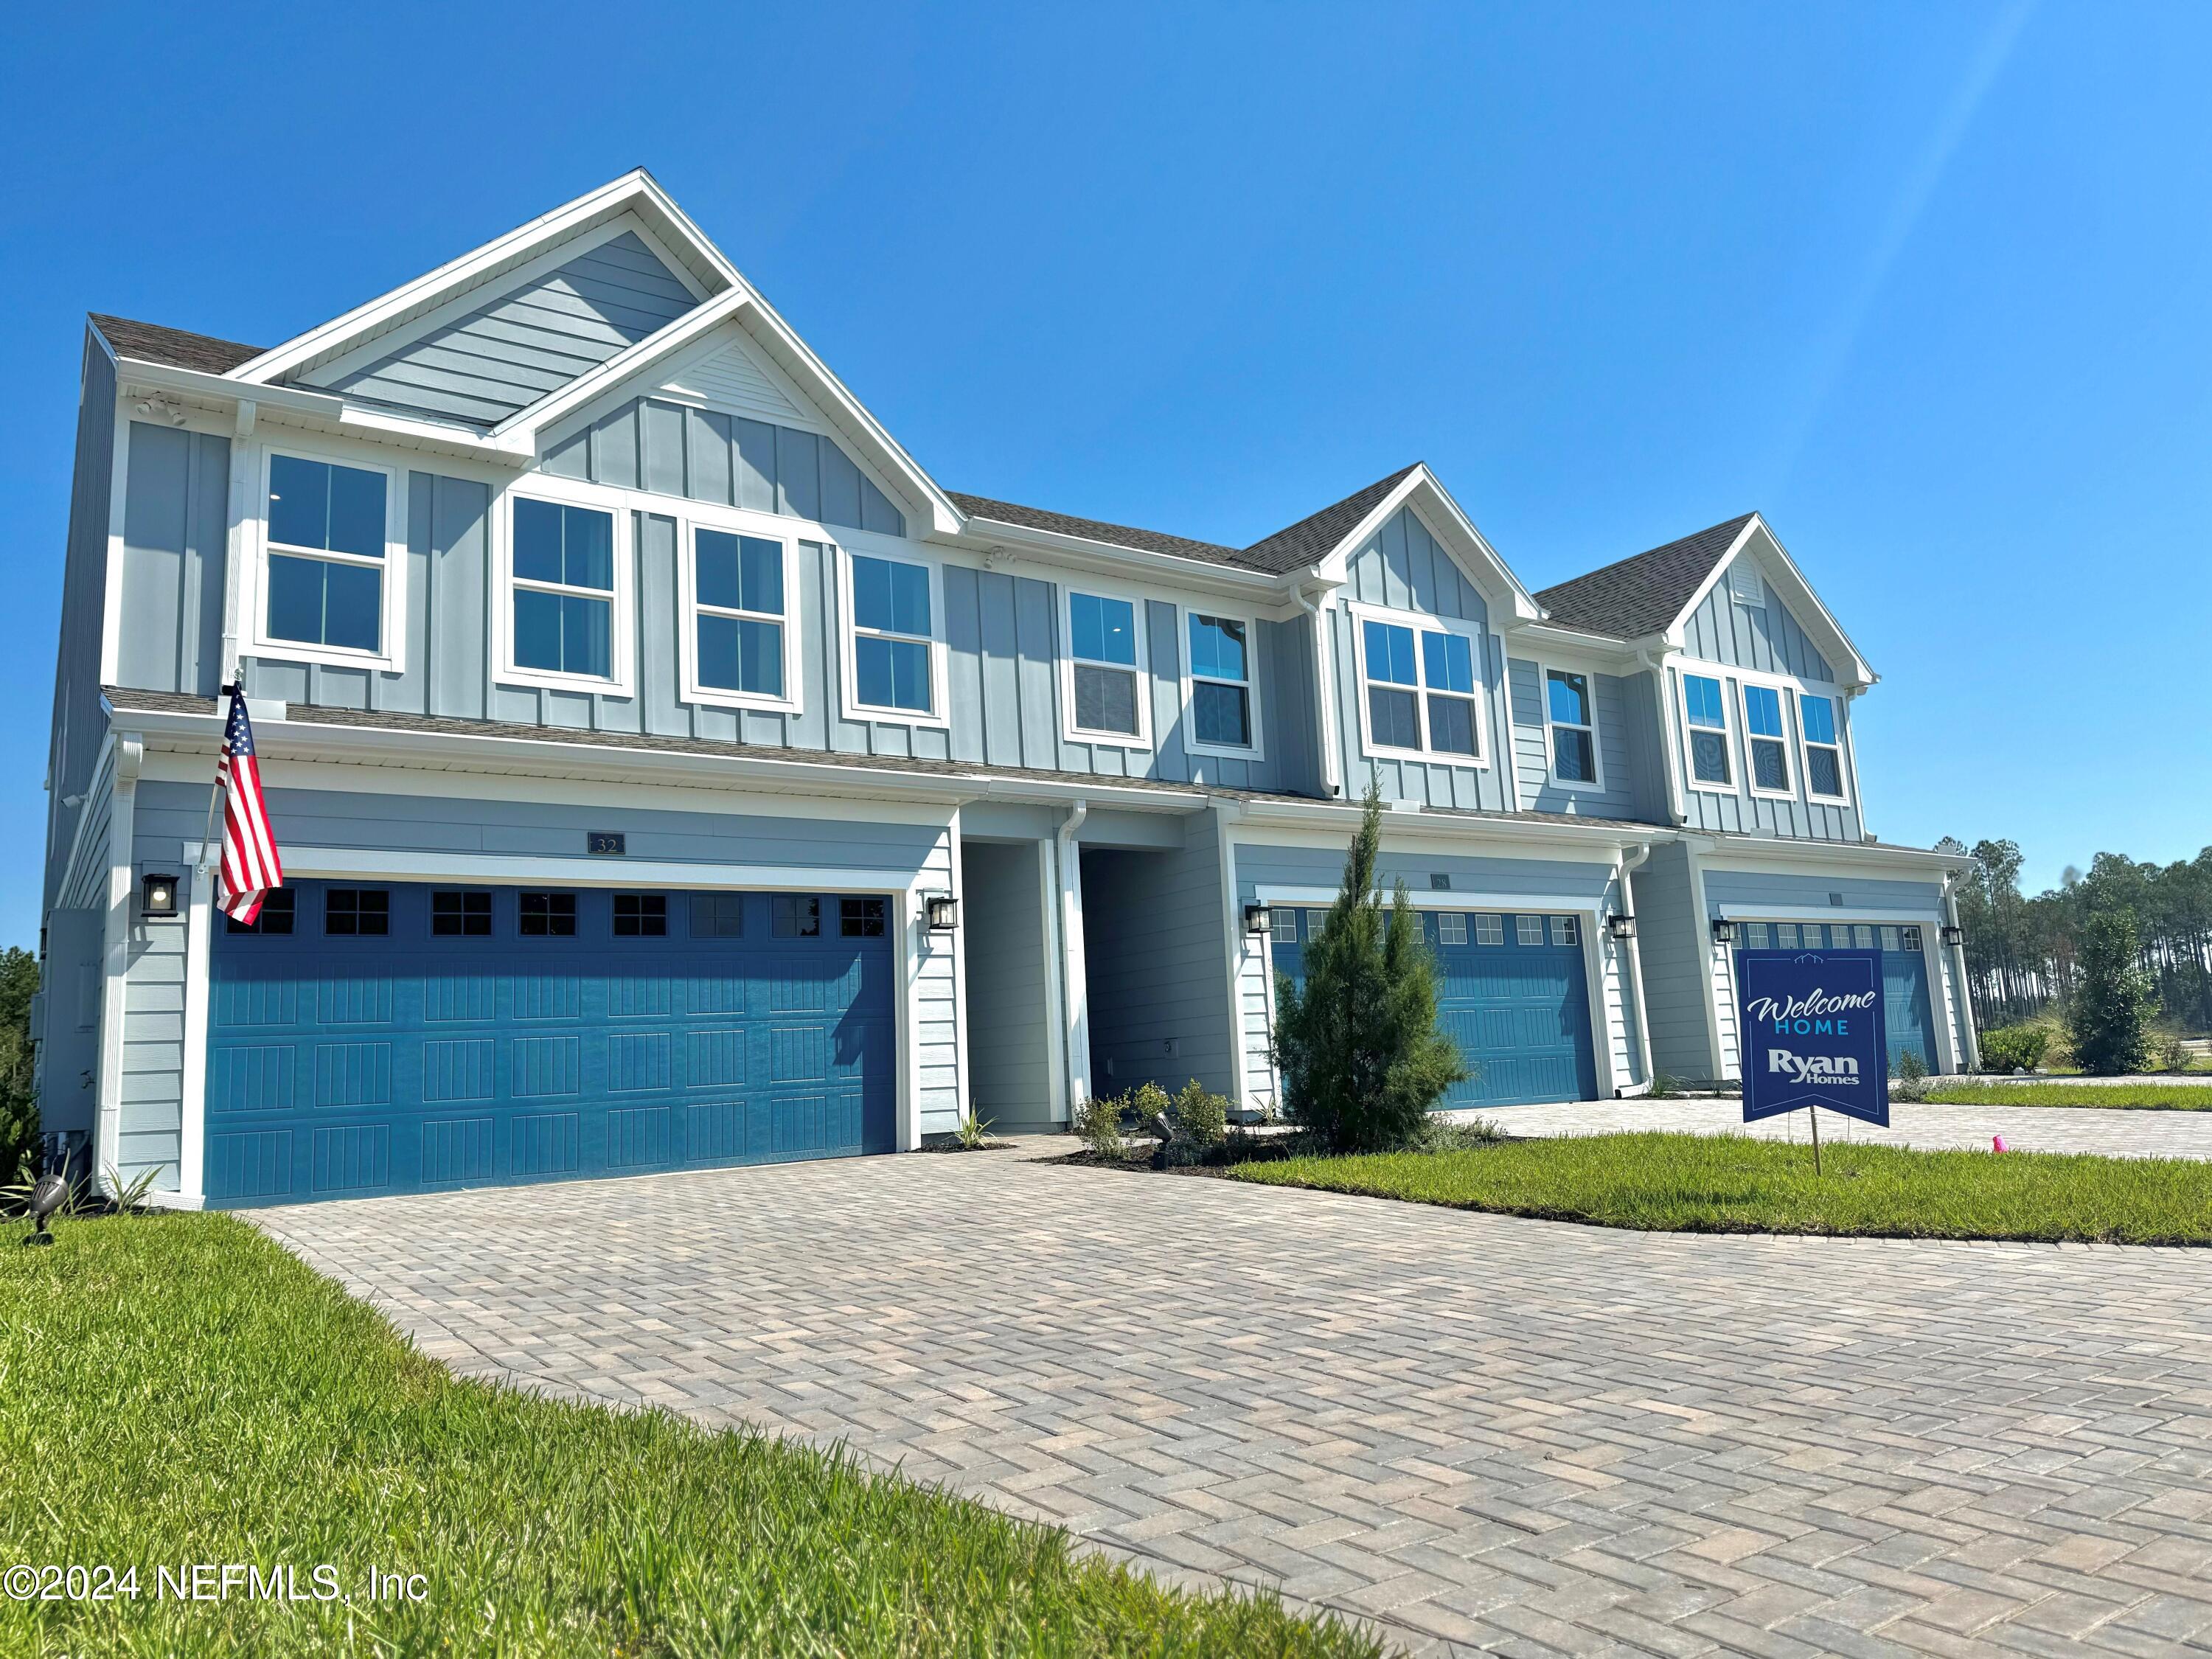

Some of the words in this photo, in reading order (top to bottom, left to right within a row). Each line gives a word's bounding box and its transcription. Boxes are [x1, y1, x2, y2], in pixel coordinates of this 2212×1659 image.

[597, 838, 617, 852] 32
[1747, 988, 1876, 1021] Welcome
[1775, 1019, 1848, 1035] HOME
[1767, 1049, 1860, 1083] Ryan
[1806, 1073, 1860, 1085] Homes
